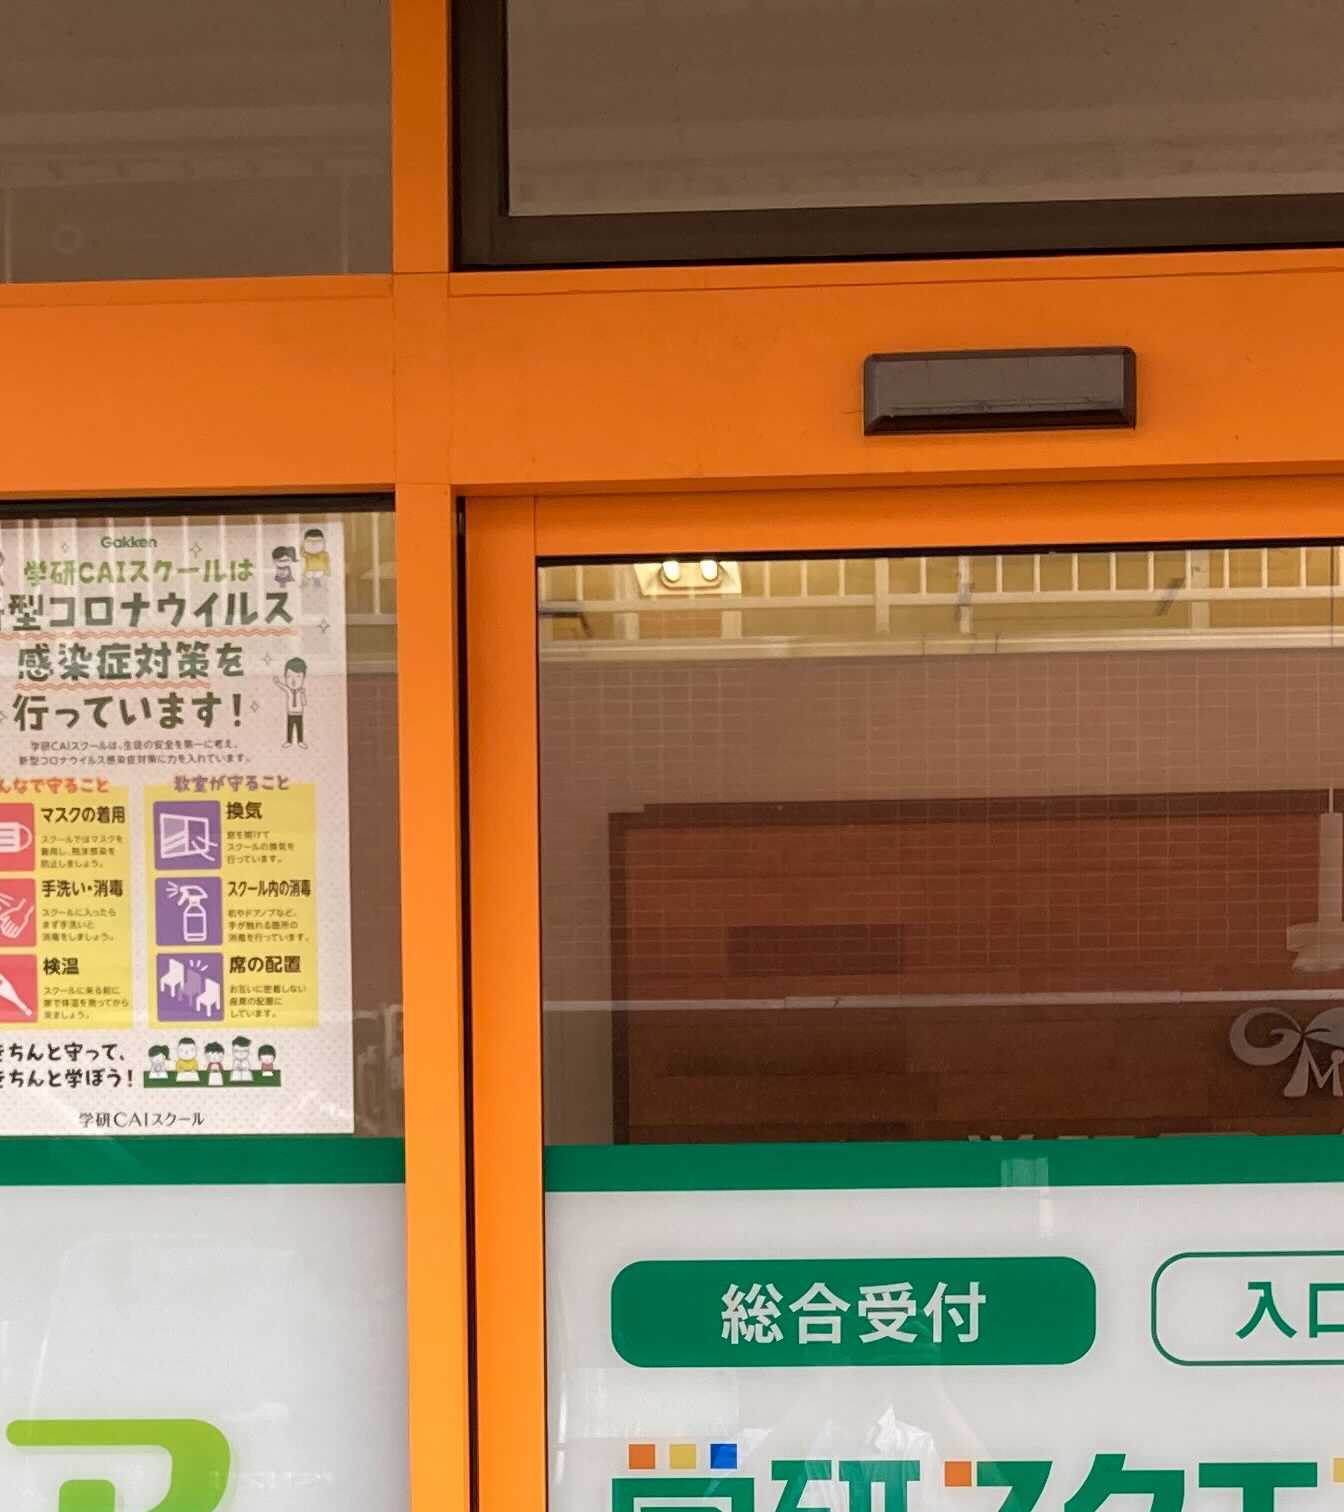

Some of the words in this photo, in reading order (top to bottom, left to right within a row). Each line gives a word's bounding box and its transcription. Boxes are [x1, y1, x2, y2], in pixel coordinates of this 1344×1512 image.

[101, 535, 157, 549] Gakken
[23, 558, 254, 586] 学研CAIスクールは
[18, 642, 244, 681] 感染症対策を
[13, 693, 243, 731] 行っています!
[174, 775, 289, 792] 教室が守ること
[40, 806, 126, 824] マスクの着用
[226, 801, 263, 820] 換気
[42, 879, 124, 897] 手洗い・消毒
[228, 879, 311, 897] スクール内の消毒
[43, 957, 79, 975] 検温
[230, 956, 301, 973] 席の配置
[79, 1111, 205, 1129] 学研CAIスクール
[720, 1282, 987, 1345] 総合受付
